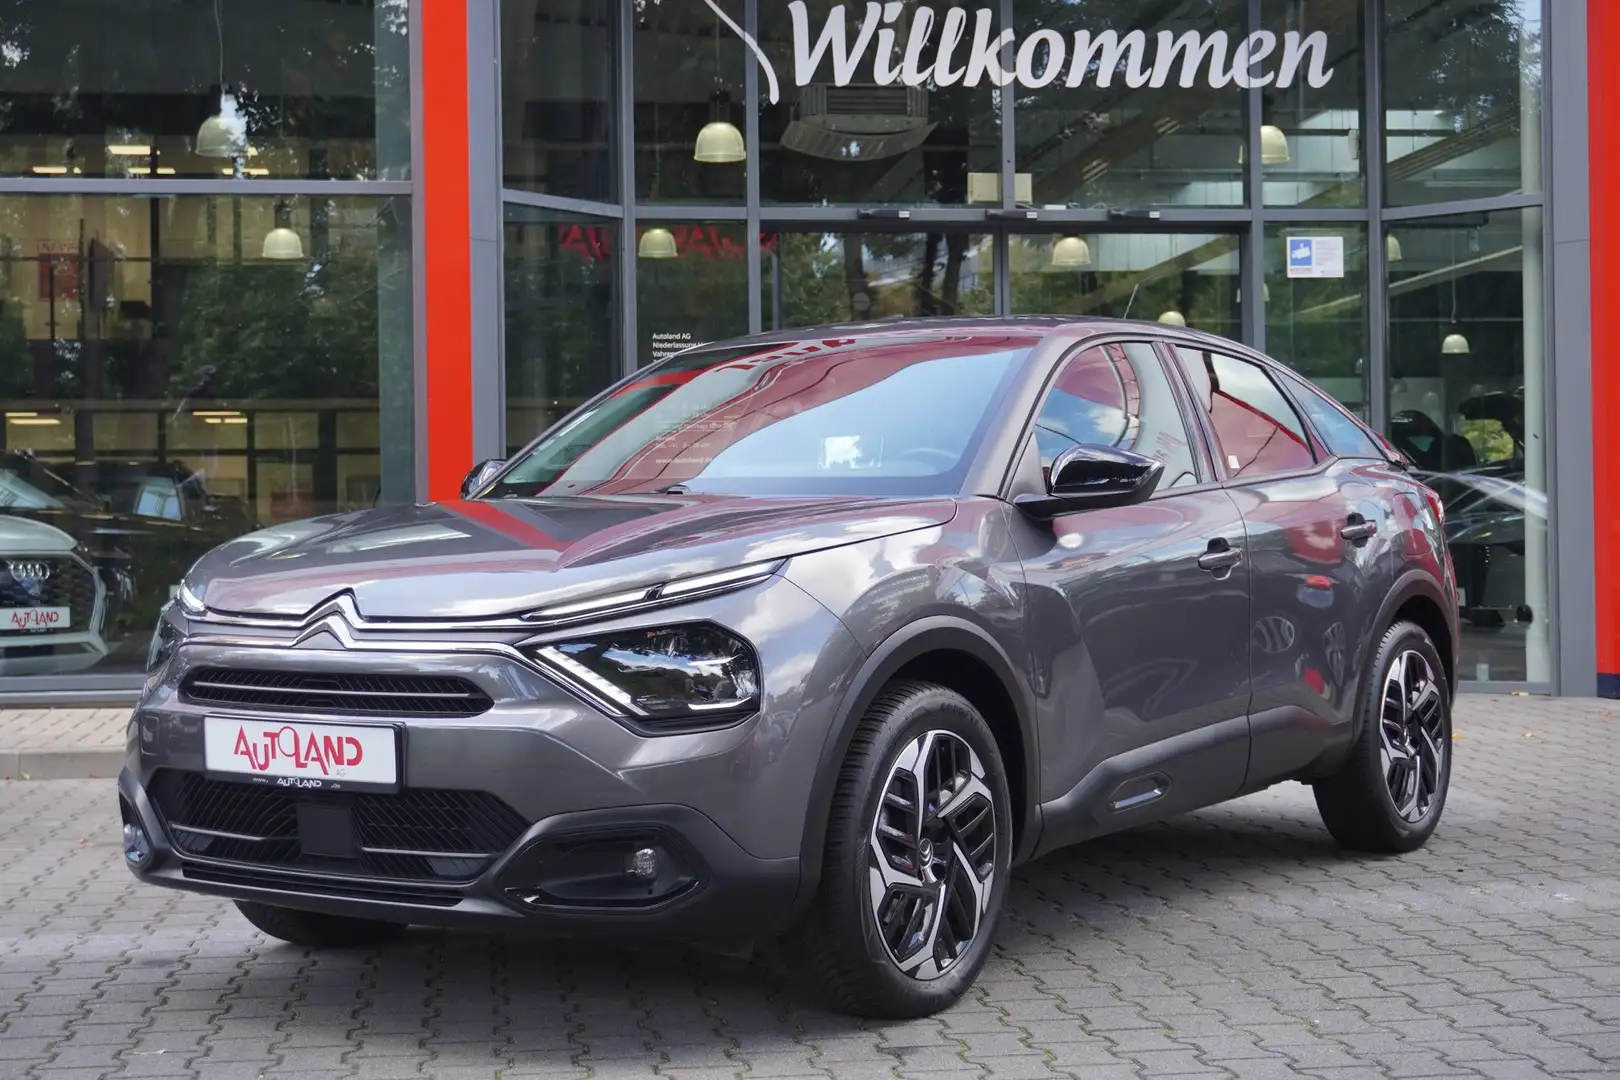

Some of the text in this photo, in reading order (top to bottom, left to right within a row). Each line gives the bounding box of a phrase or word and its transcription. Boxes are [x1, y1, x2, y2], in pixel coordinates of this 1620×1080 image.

[788, 0, 1333, 89] Willkommen
[681, 332, 692, 340] AG
[11, 608, 60, 628] AUTOLAND
[233, 725, 364, 775] AUTOLAND
[277, 776, 323, 789] AUTOLAND
